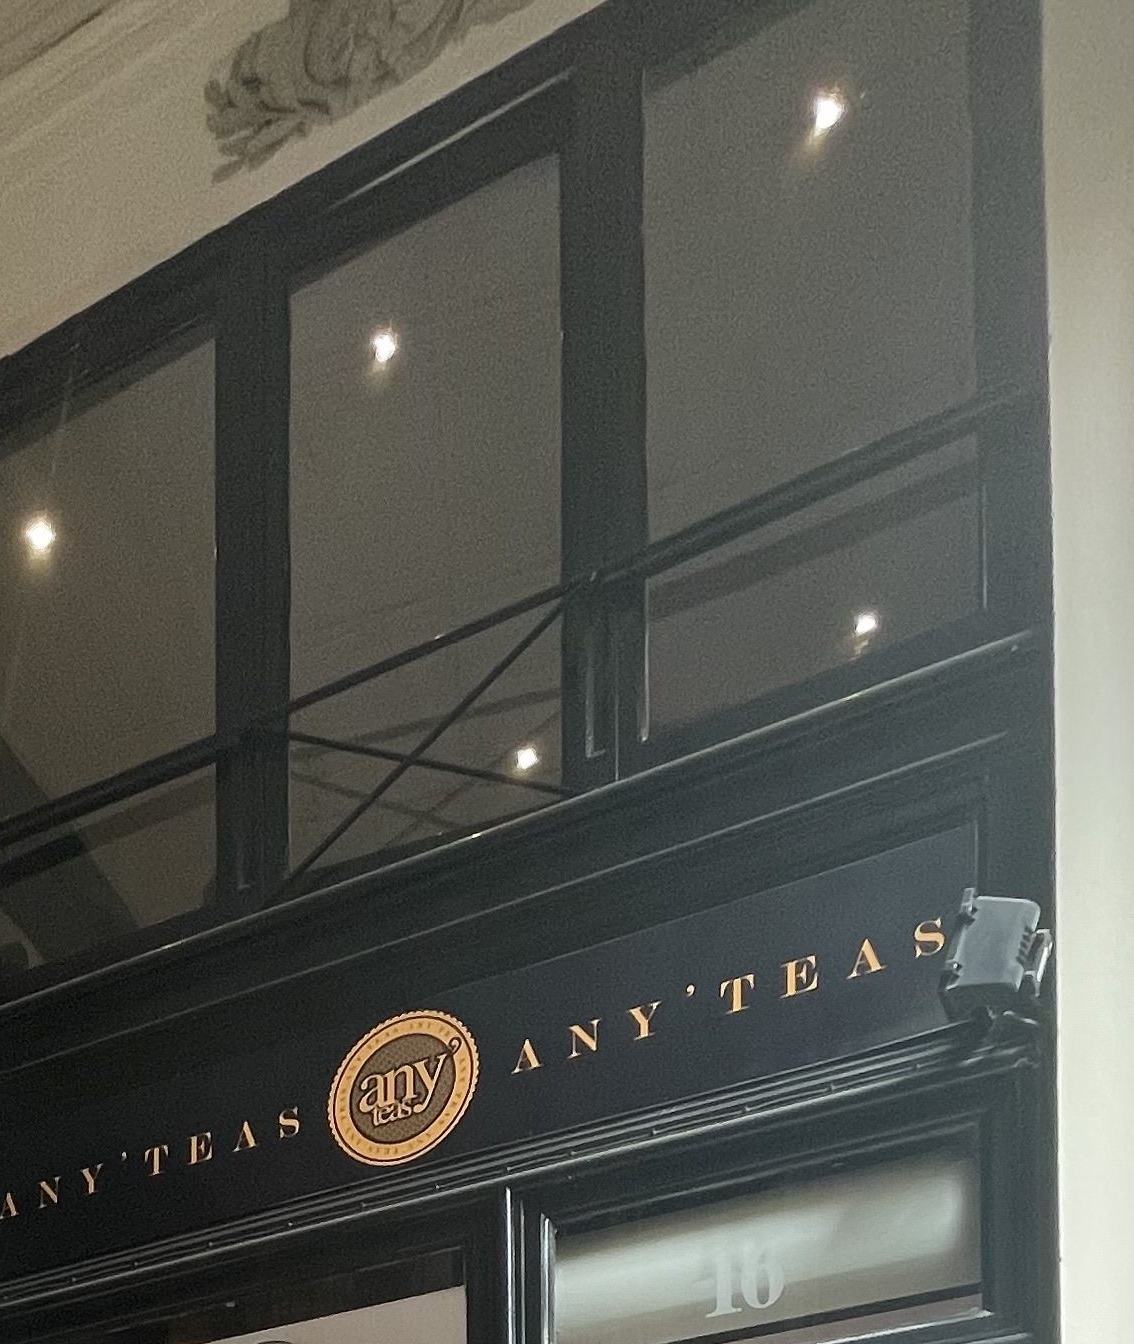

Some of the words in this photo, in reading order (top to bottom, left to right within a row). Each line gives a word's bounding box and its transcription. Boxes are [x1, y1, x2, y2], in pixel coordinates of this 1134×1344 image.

[511, 917, 946, 1075] ANY'TEAS
[372, 1100, 413, 1126] teas
[704, 1240, 785, 1318] 16
